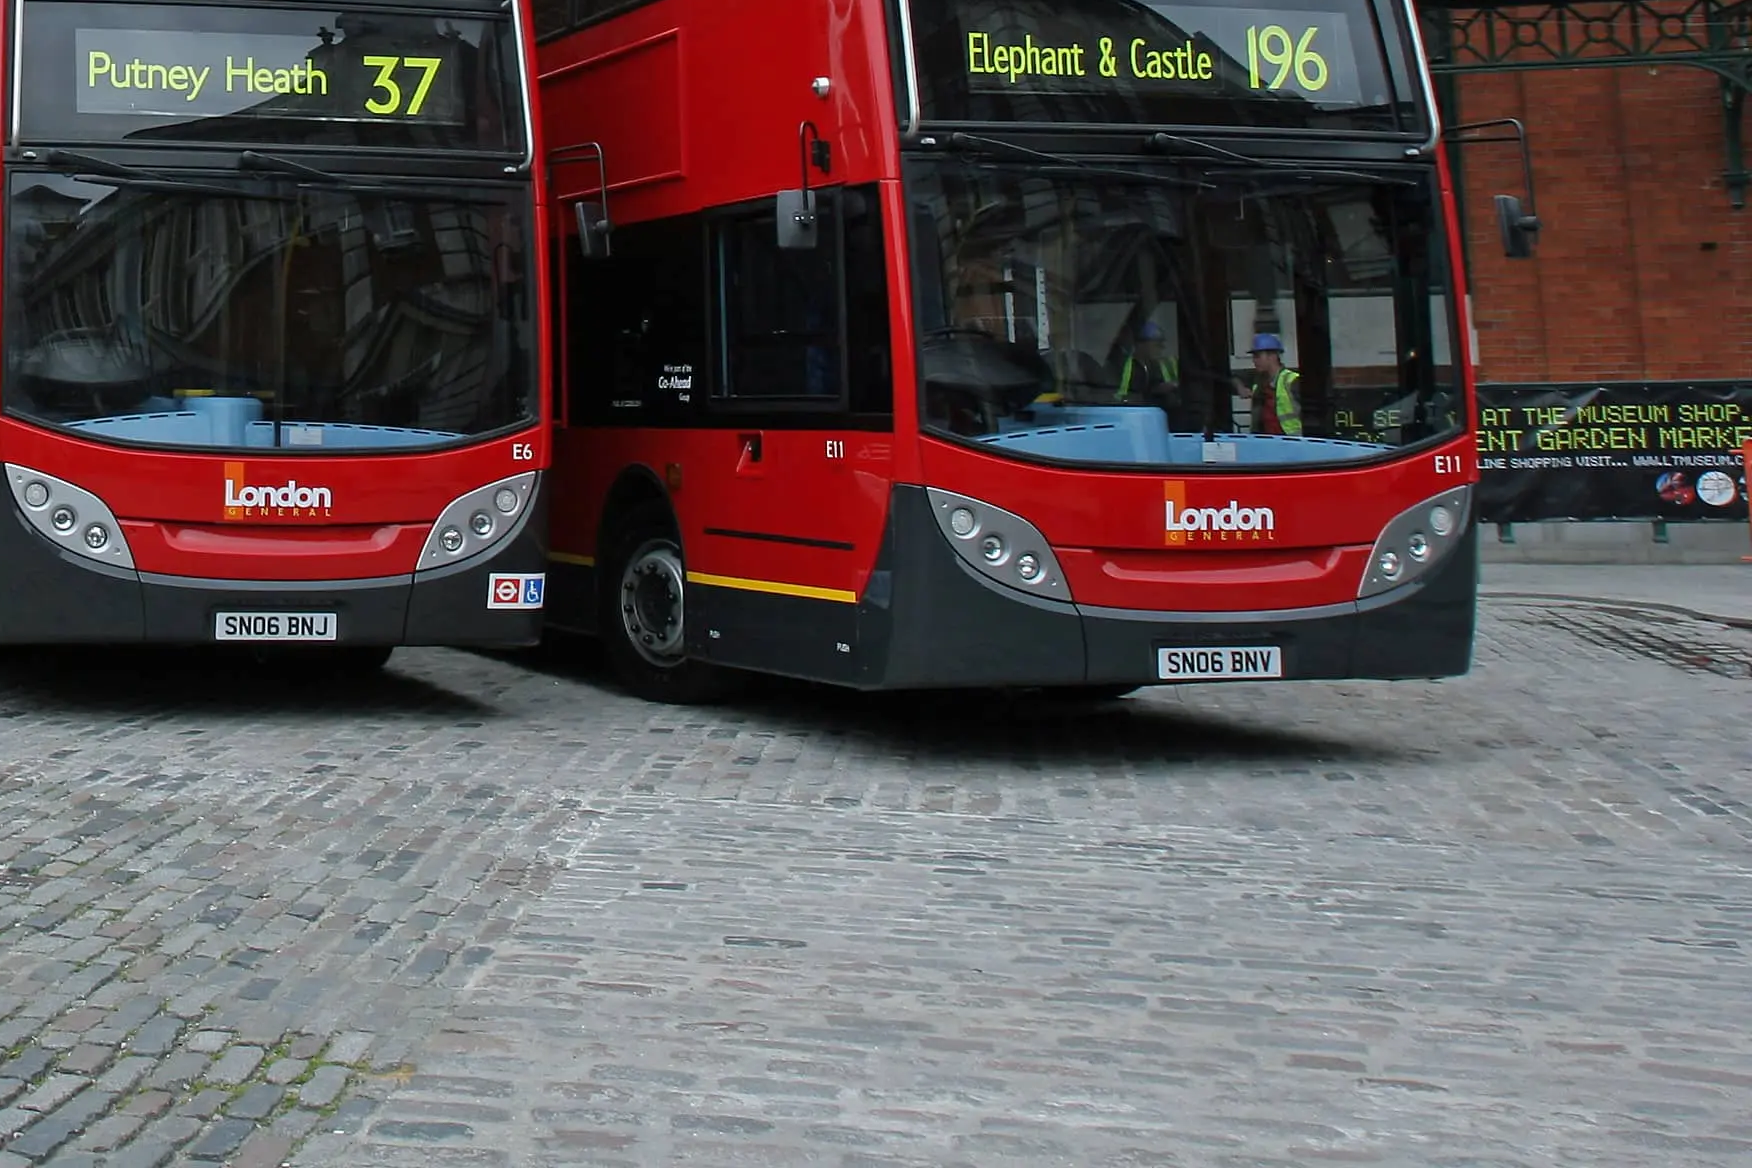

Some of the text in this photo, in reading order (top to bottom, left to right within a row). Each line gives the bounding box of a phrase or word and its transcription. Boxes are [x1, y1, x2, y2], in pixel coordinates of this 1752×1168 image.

[968, 24, 1328, 91] Elephant & Castle 196
[88, 51, 442, 116] Putney Heath 37
[1481, 408, 1512, 426] AT
[1521, 407, 1569, 426] THE
[1575, 404, 1669, 424] MUSEUM
[1535, 426, 1648, 451] GARDEN
[512, 442, 533, 461] E6
[826, 440, 844, 459] E11
[1434, 455, 1461, 473] E11
[1510, 456, 1573, 469] SHOPPING
[225, 479, 332, 508] London
[228, 507, 331, 517] GENERAL
[1165, 500, 1274, 531] London
[1169, 531, 1274, 542] GENERAL
[224, 616, 328, 636] SN06 BNJ
[1167, 650, 1272, 673] SN06 BNV
